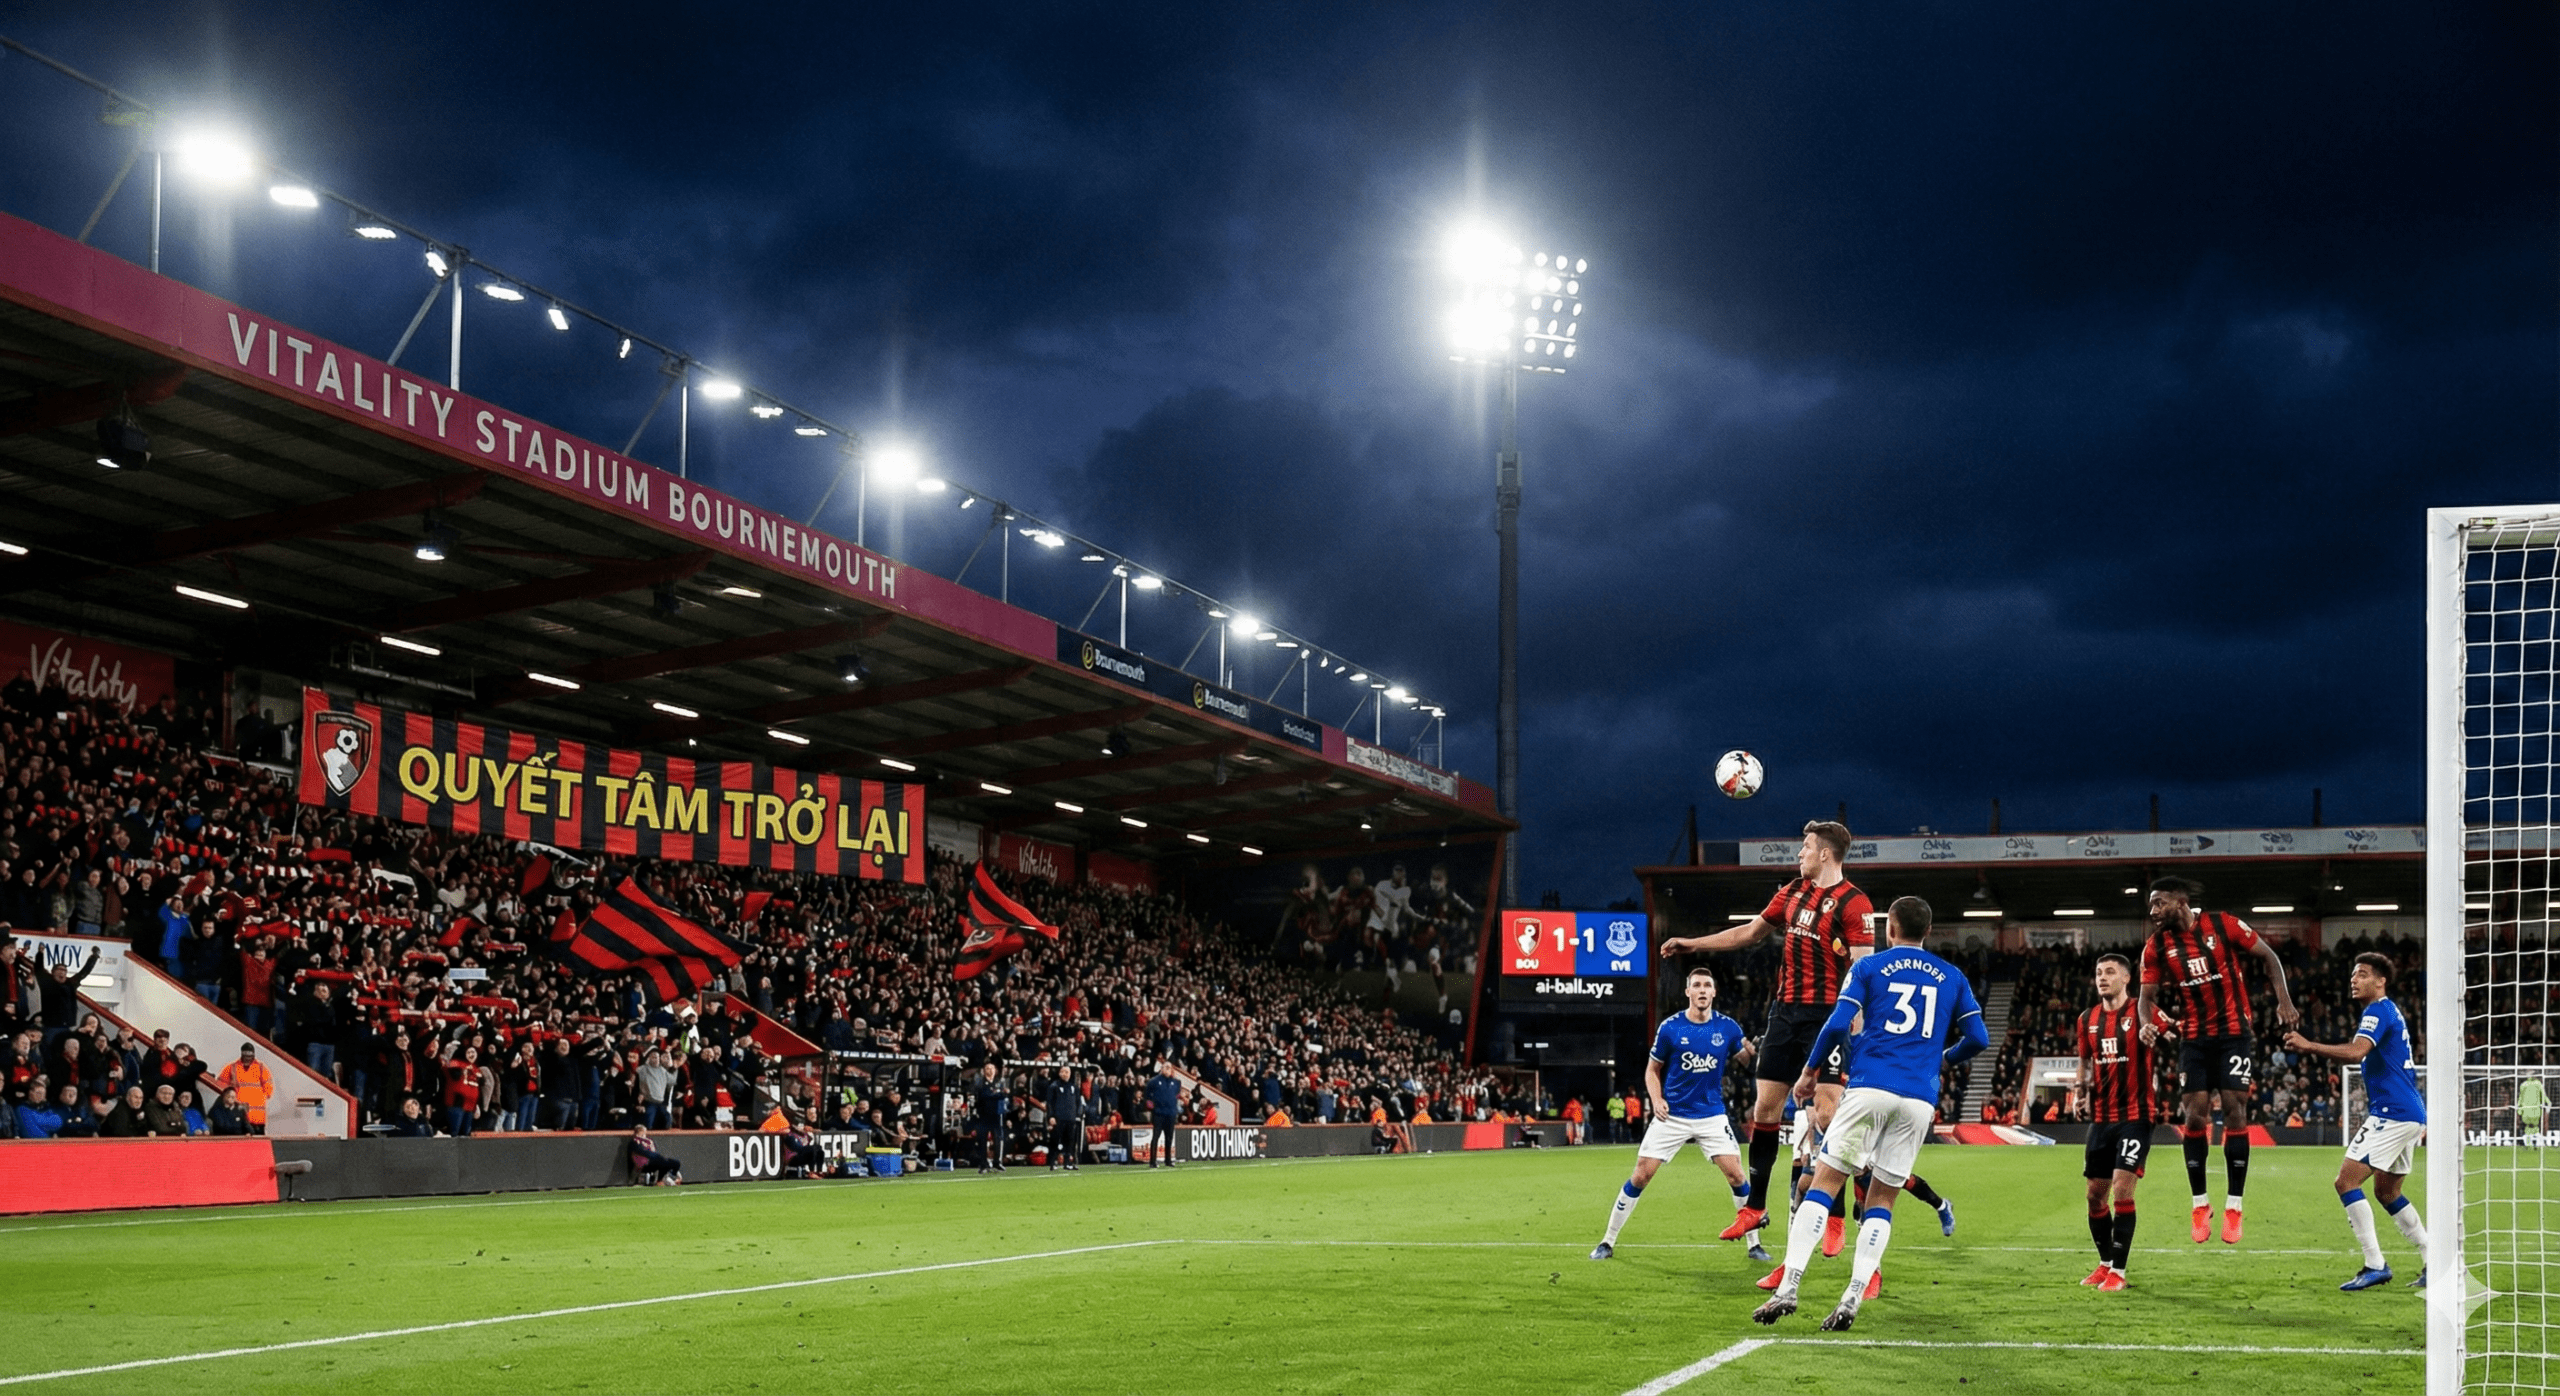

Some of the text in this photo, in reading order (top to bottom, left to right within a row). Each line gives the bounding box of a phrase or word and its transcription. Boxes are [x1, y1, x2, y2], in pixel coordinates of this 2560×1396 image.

[227, 312, 895, 599] VITALITY STADIUM BOURNEMOUTH
[30, 637, 138, 719] Vitality
[398, 747, 909, 865] QUYẾT TÂM TRỞ LẠI
[1515, 959, 1540, 970] BOU
[1535, 978, 1614, 999] ai-ball.xyz
[1884, 982, 1938, 1039] 31
[1828, 1044, 1842, 1067] 6
[2229, 1055, 2251, 1077] 22
[1191, 1129, 1217, 1158] BOU
[2354, 1126, 2369, 1144] 3
[729, 1135, 780, 1177] BOU
[2121, 1138, 2141, 1160] 12
